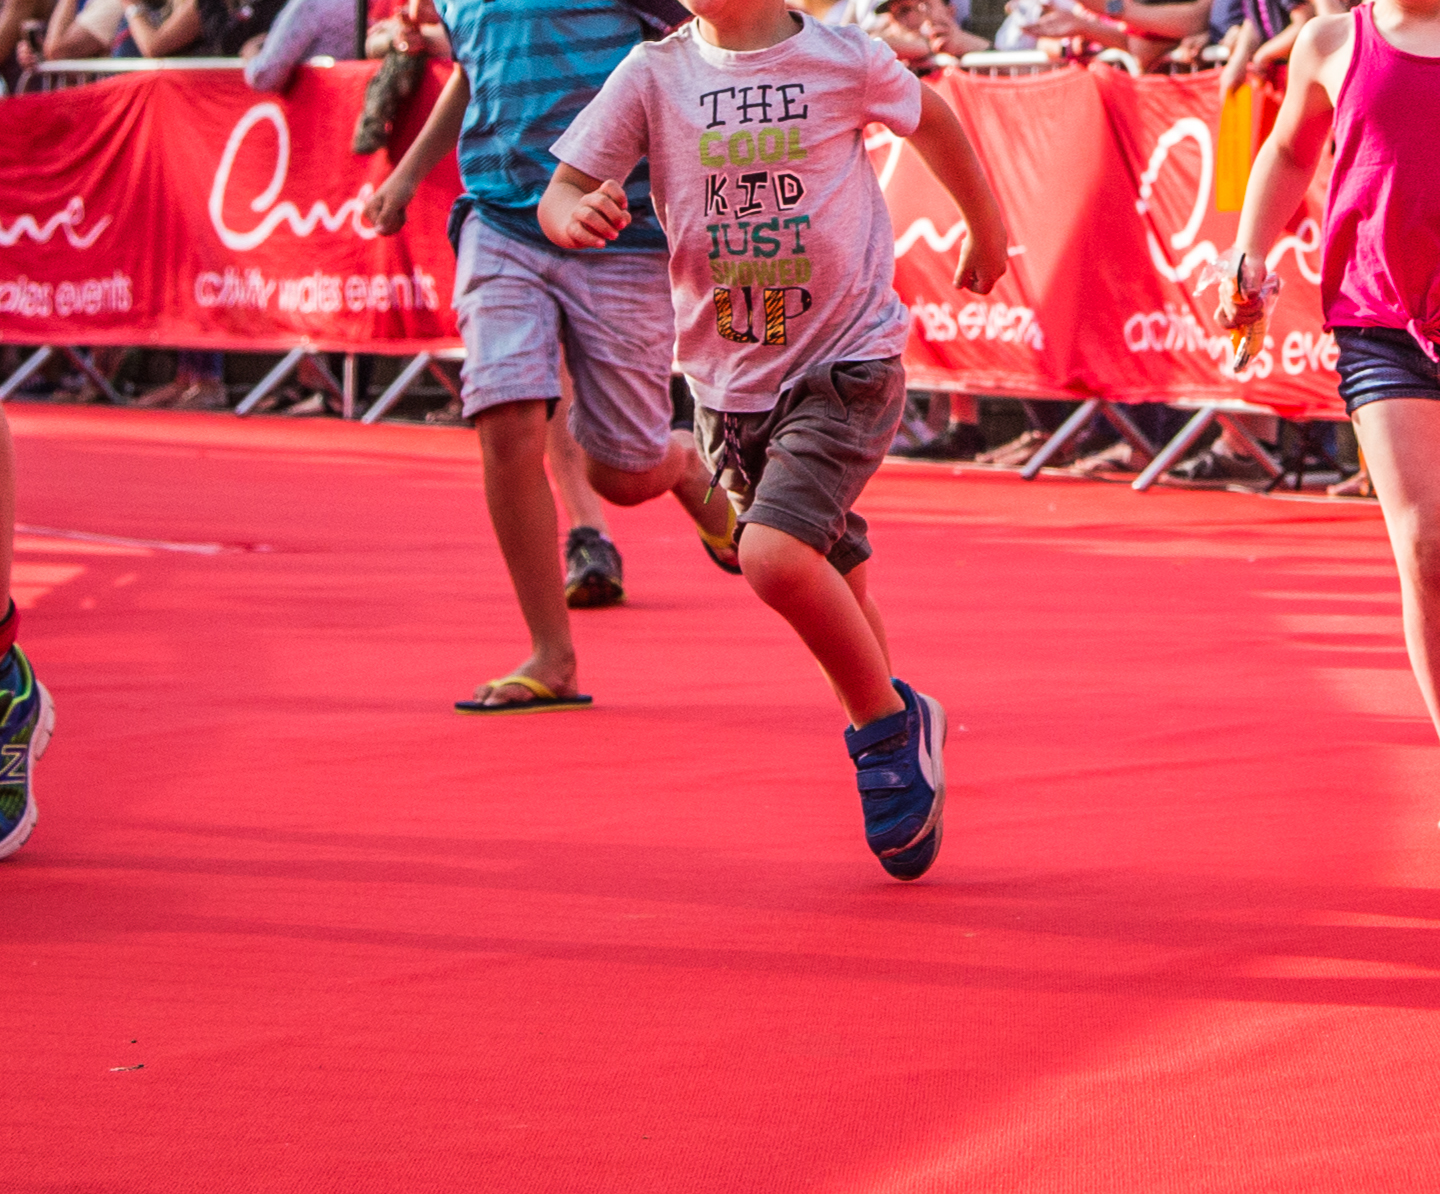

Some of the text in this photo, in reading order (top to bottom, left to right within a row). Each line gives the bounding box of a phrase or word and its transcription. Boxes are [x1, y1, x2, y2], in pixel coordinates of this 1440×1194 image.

[700, 84, 808, 129] THE
[699, 127, 807, 167] COOL
[705, 170, 807, 219] KID
[706, 215, 811, 259] JUST
[710, 258, 812, 286] SHOWED
[714, 286, 812, 346] UP
